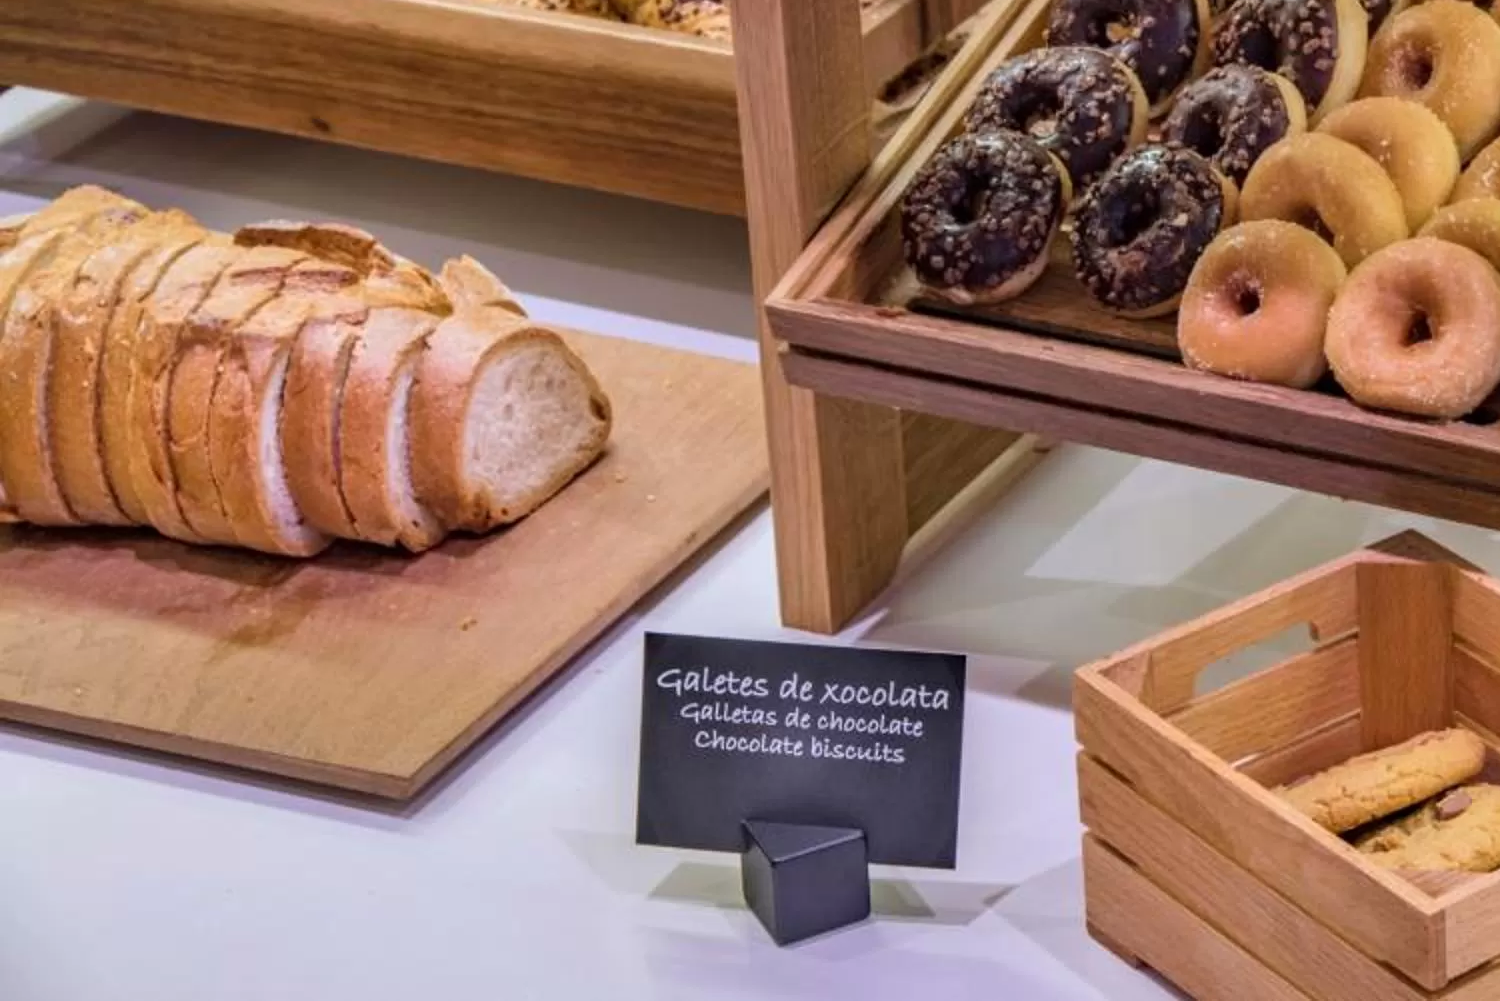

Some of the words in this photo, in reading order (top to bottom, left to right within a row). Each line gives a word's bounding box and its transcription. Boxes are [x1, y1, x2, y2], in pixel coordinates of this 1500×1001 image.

[656, 666, 770, 697] Galetes
[779, 672, 813, 702] de
[819, 680, 950, 710] xocolata
[680, 701, 779, 726] Galletas
[785, 707, 811, 729] de
[817, 710, 924, 737] chocolate
[694, 729, 804, 756] Chocolate
[811, 735, 906, 763] biscuits
